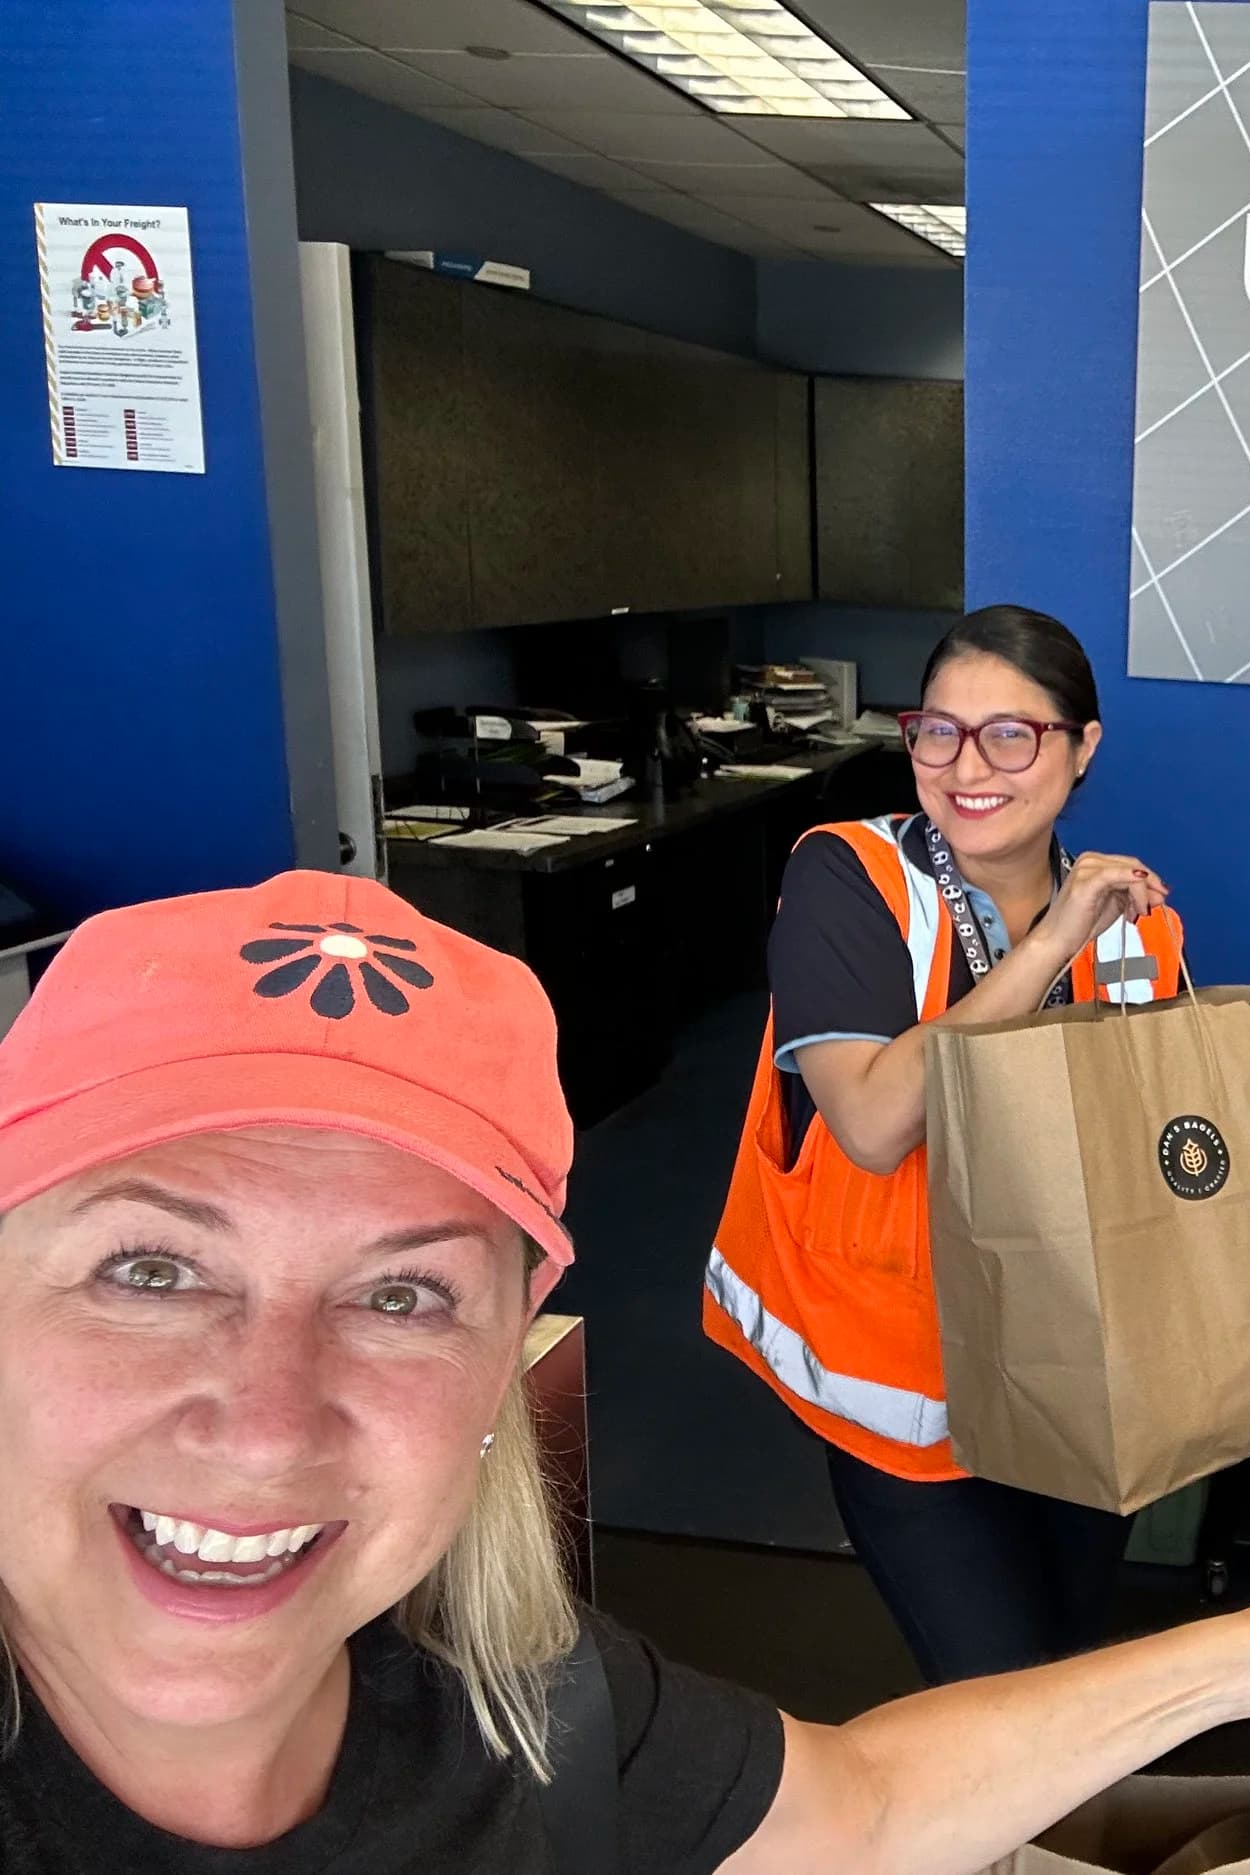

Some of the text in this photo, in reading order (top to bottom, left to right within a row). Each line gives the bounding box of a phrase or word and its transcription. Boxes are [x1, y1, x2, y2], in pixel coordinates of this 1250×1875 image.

[58, 216, 161, 230] What's In Your Freight?
[1183, 1121, 1221, 1146] BAGELS
